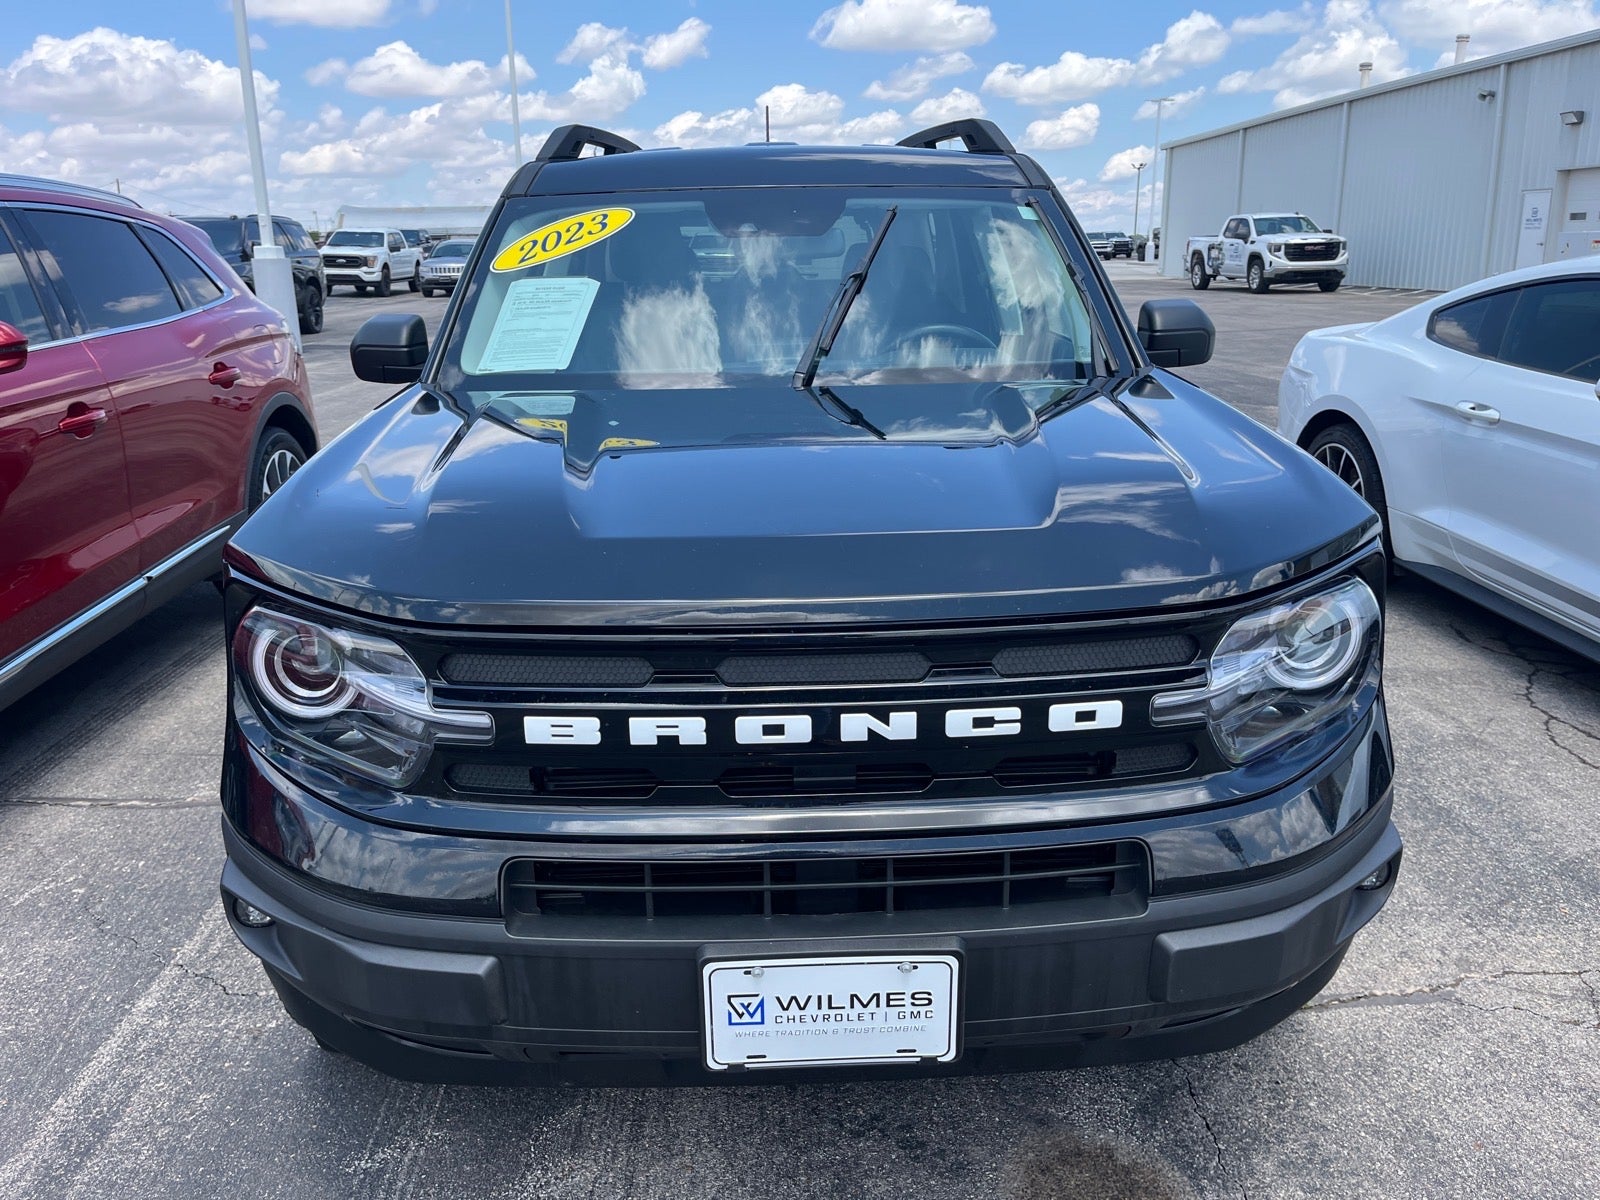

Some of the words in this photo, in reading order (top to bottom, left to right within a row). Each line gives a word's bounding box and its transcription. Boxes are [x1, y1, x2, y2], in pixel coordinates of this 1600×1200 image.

[518, 213, 608, 264] 2023
[523, 700, 1123, 746] BRONCO
[775, 991, 933, 1011] WILMES
[774, 1012, 877, 1024] CHEVROLET
[897, 1009, 934, 1020] GMC
[734, 1030, 772, 1039] WHERE
[775, 1028, 828, 1037] TRADITION
[832, 1027, 839, 1035] &
[843, 1026, 876, 1035] TRUST
[879, 1024, 927, 1034] COMBINE
